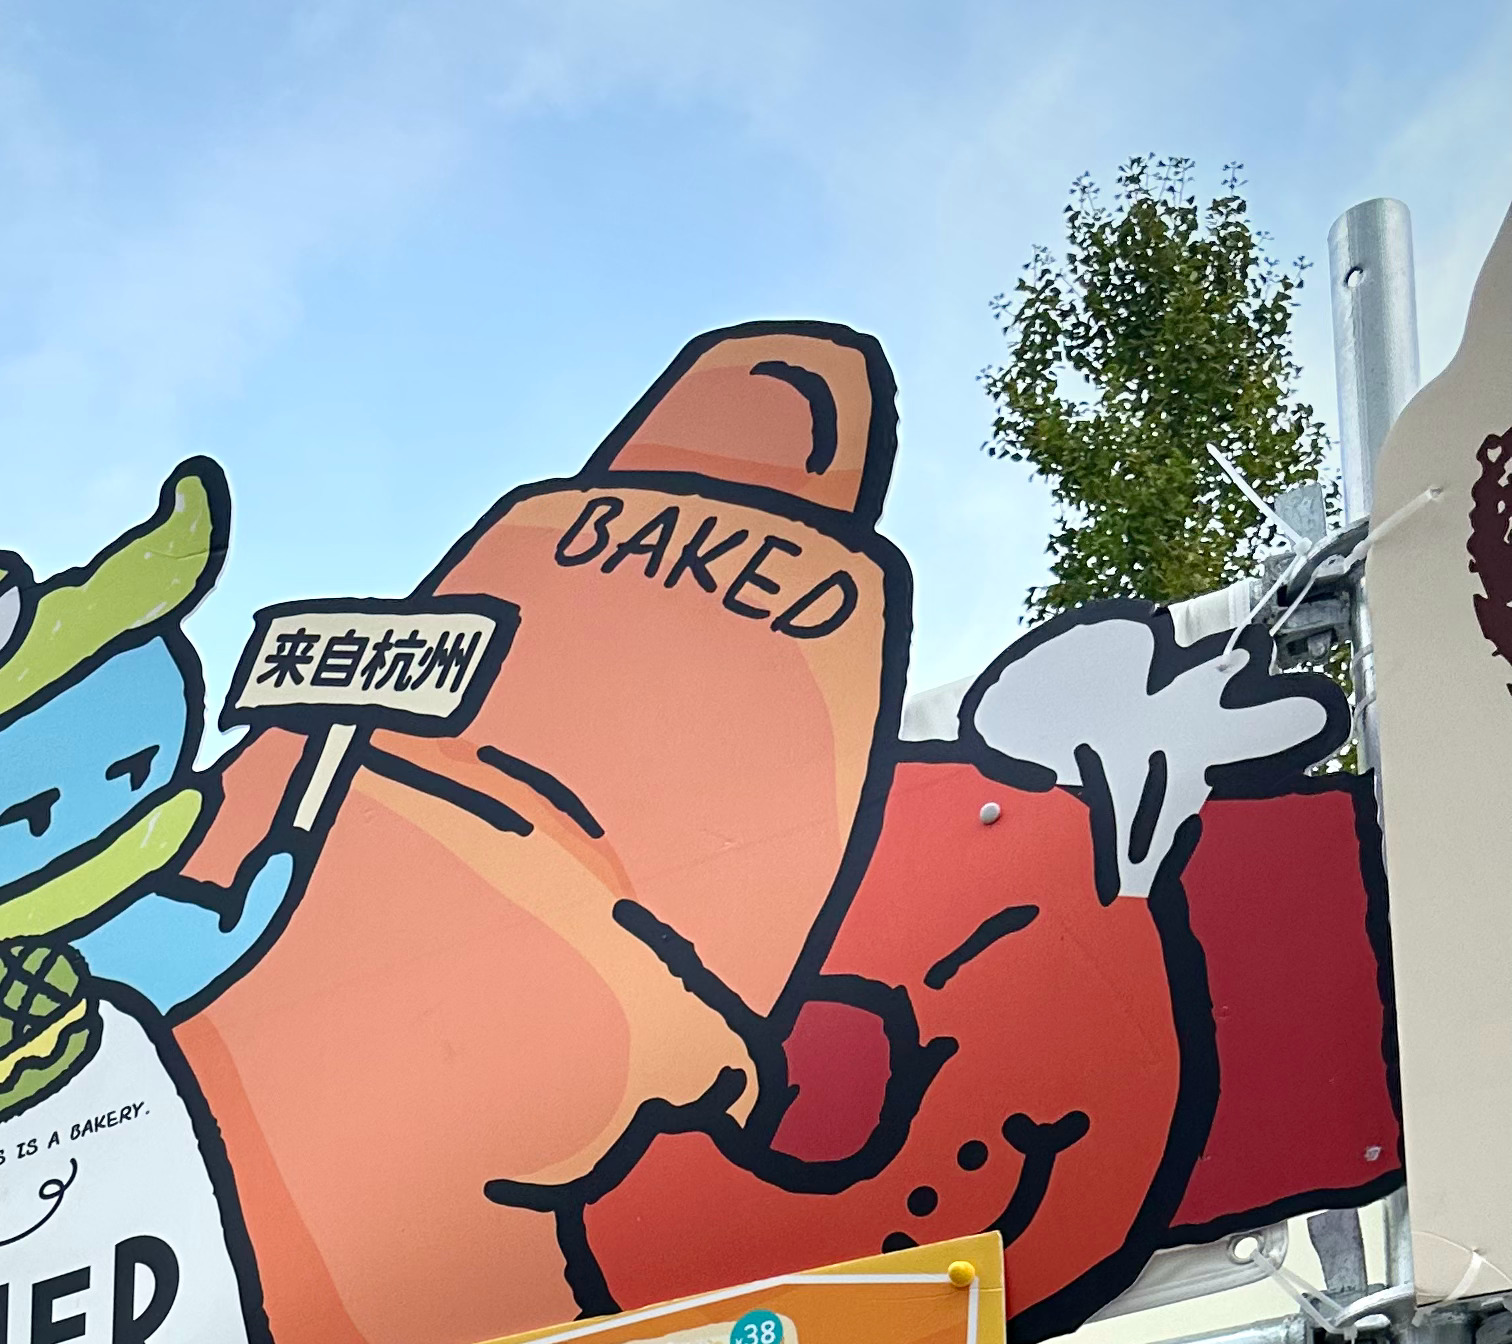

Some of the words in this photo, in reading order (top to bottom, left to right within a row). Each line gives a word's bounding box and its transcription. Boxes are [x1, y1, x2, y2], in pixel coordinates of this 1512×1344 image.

[555, 497, 859, 640] BAKED
[255, 628, 482, 694] 来自杭州
[17, 1140, 39, 1161] IS
[47, 1132, 61, 1149] A
[70, 1100, 150, 1142] BAKERY.
